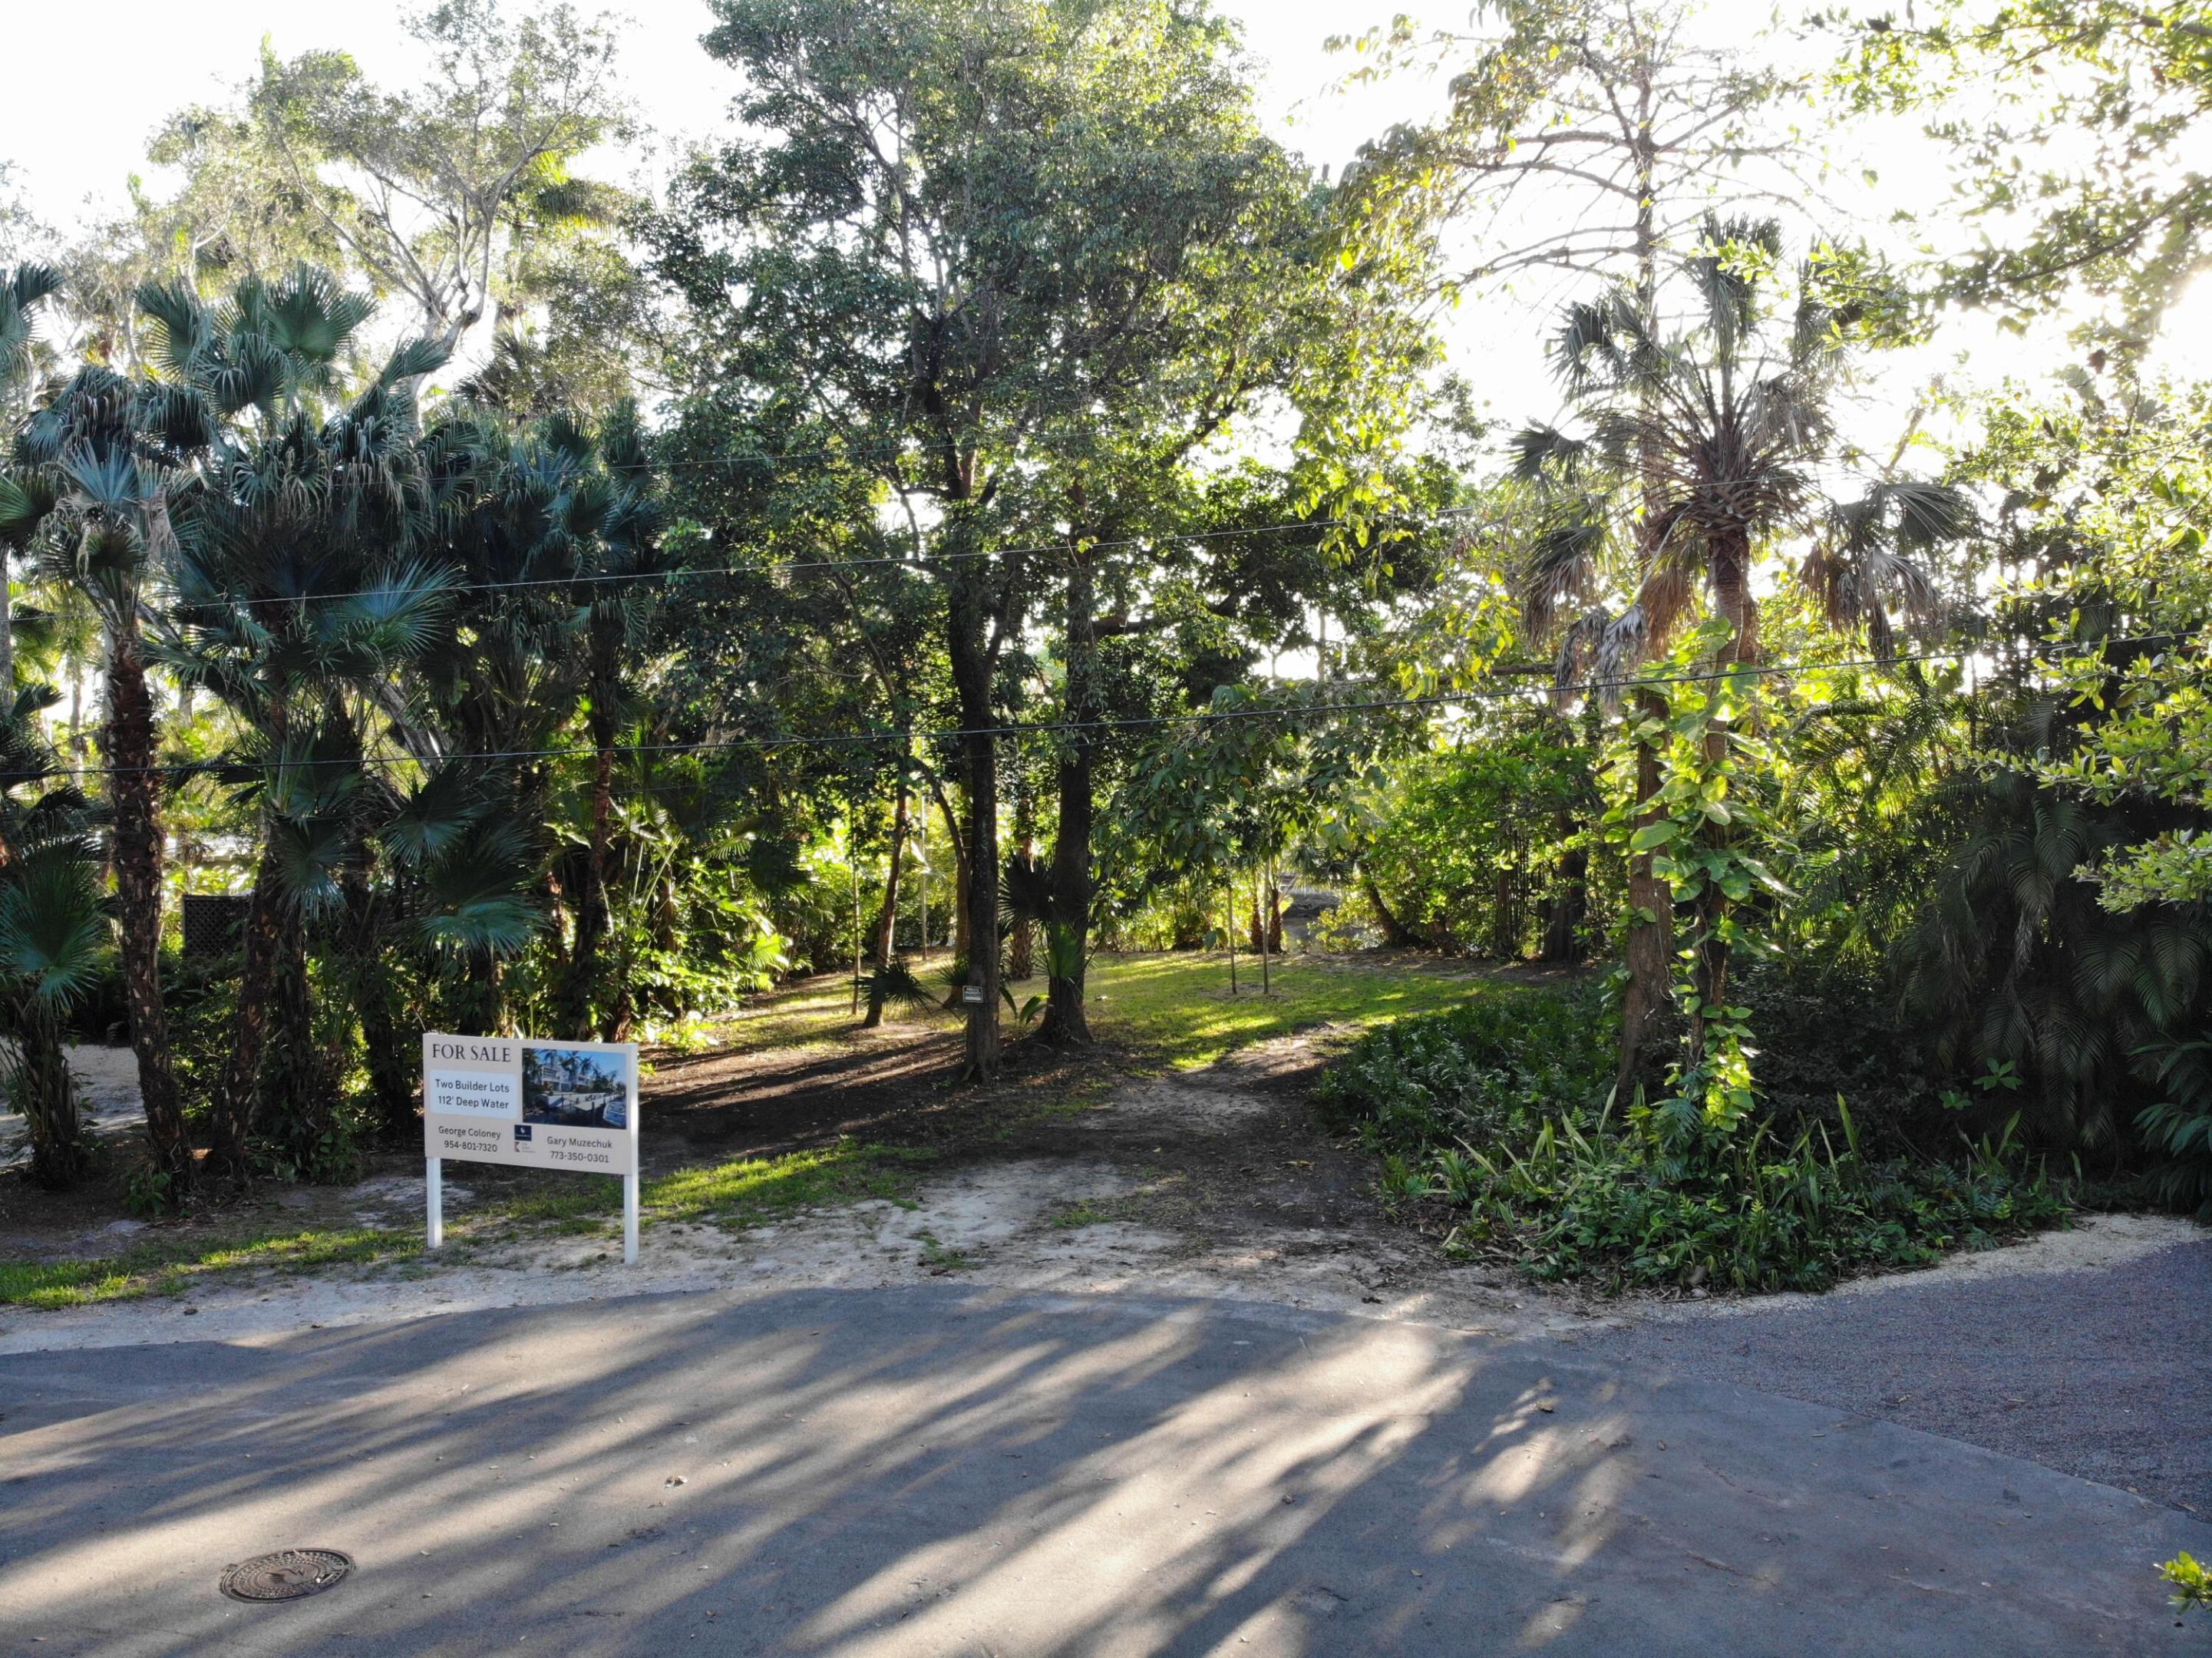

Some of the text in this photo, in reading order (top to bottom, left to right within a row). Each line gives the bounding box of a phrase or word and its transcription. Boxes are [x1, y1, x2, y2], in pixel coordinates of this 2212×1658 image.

[432, 1043, 511, 1062] FOR SALE
[435, 1078, 510, 1093] Two Builder Lots
[438, 1095, 510, 1109] 112' Deep Water
[438, 1126, 466, 1138] George
[468, 1128, 501, 1141] Coloney
[444, 1140, 498, 1152] 954-801-7320
[546, 1136, 566, 1148] Gary
[569, 1138, 612, 1148] Muzechuk
[550, 1151, 609, 1163] 773-350-0301
